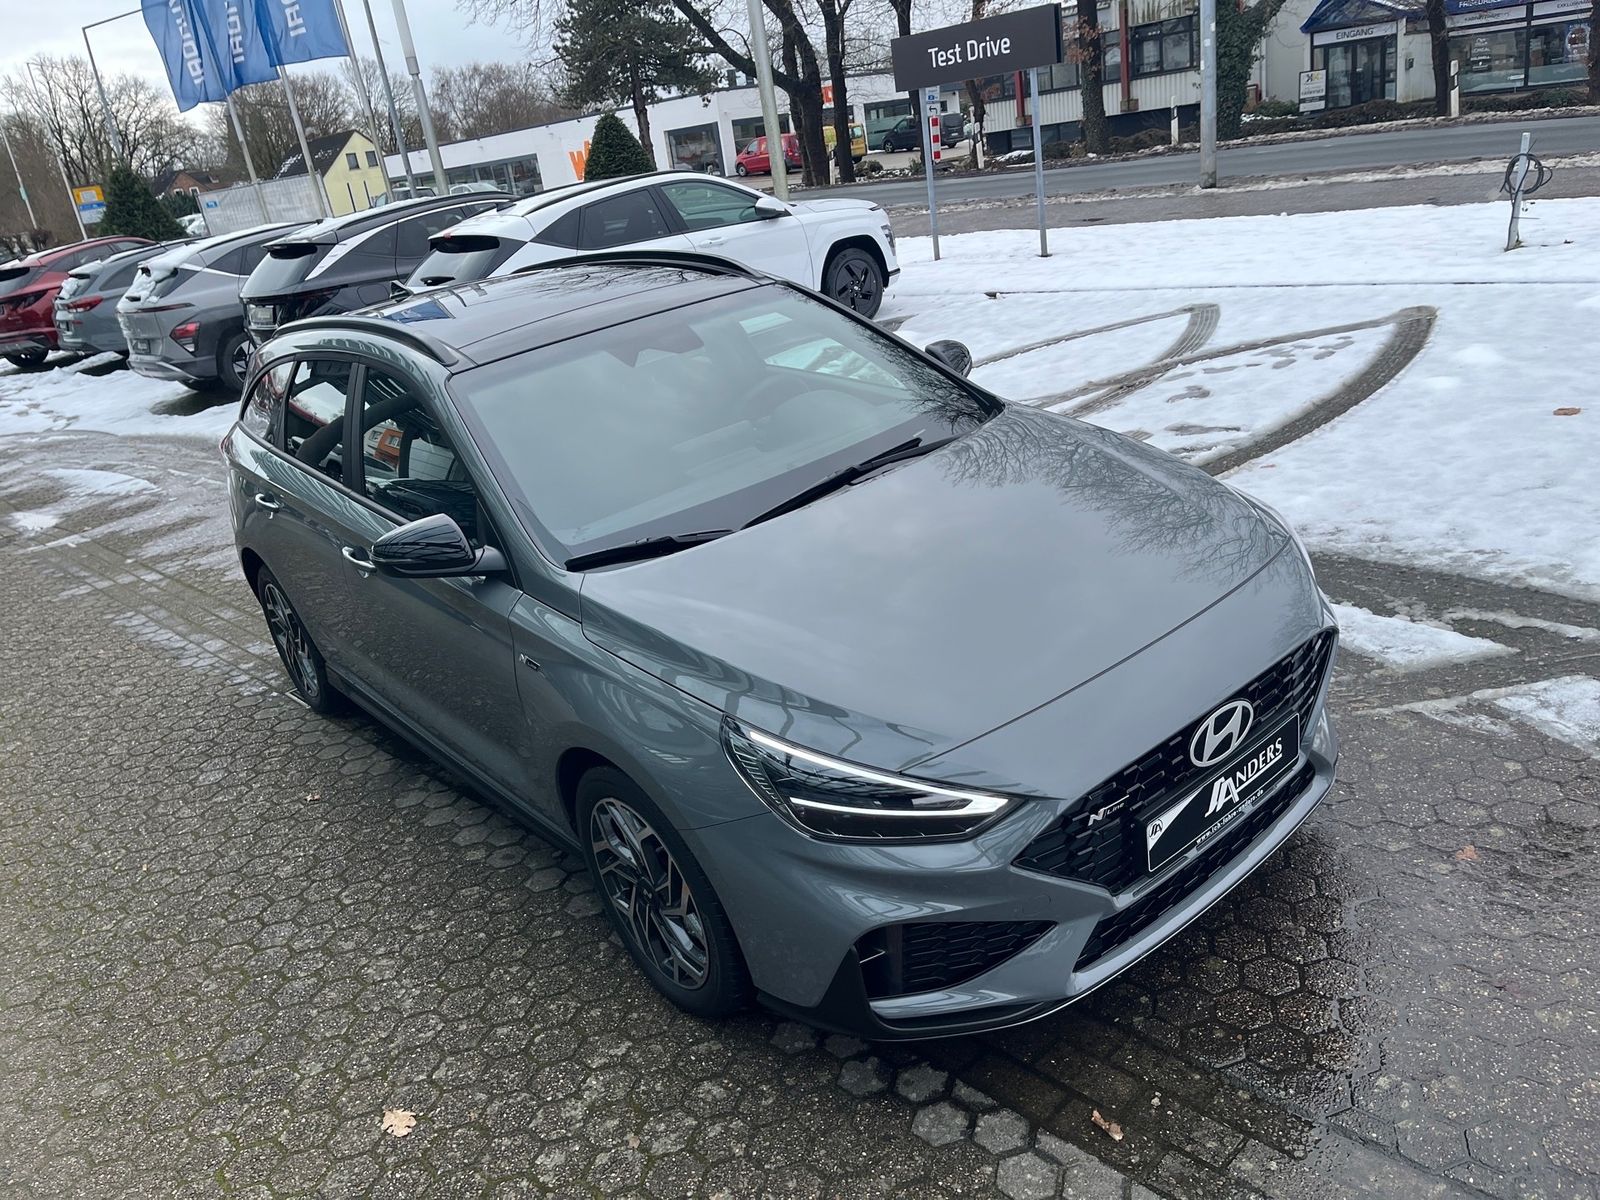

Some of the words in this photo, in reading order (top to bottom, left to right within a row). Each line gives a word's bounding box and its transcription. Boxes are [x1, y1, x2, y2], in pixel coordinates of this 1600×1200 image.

[1335, 27, 1375, 40] EINGANG
[927, 43, 963, 68] Test
[966, 35, 1011, 62] Drive
